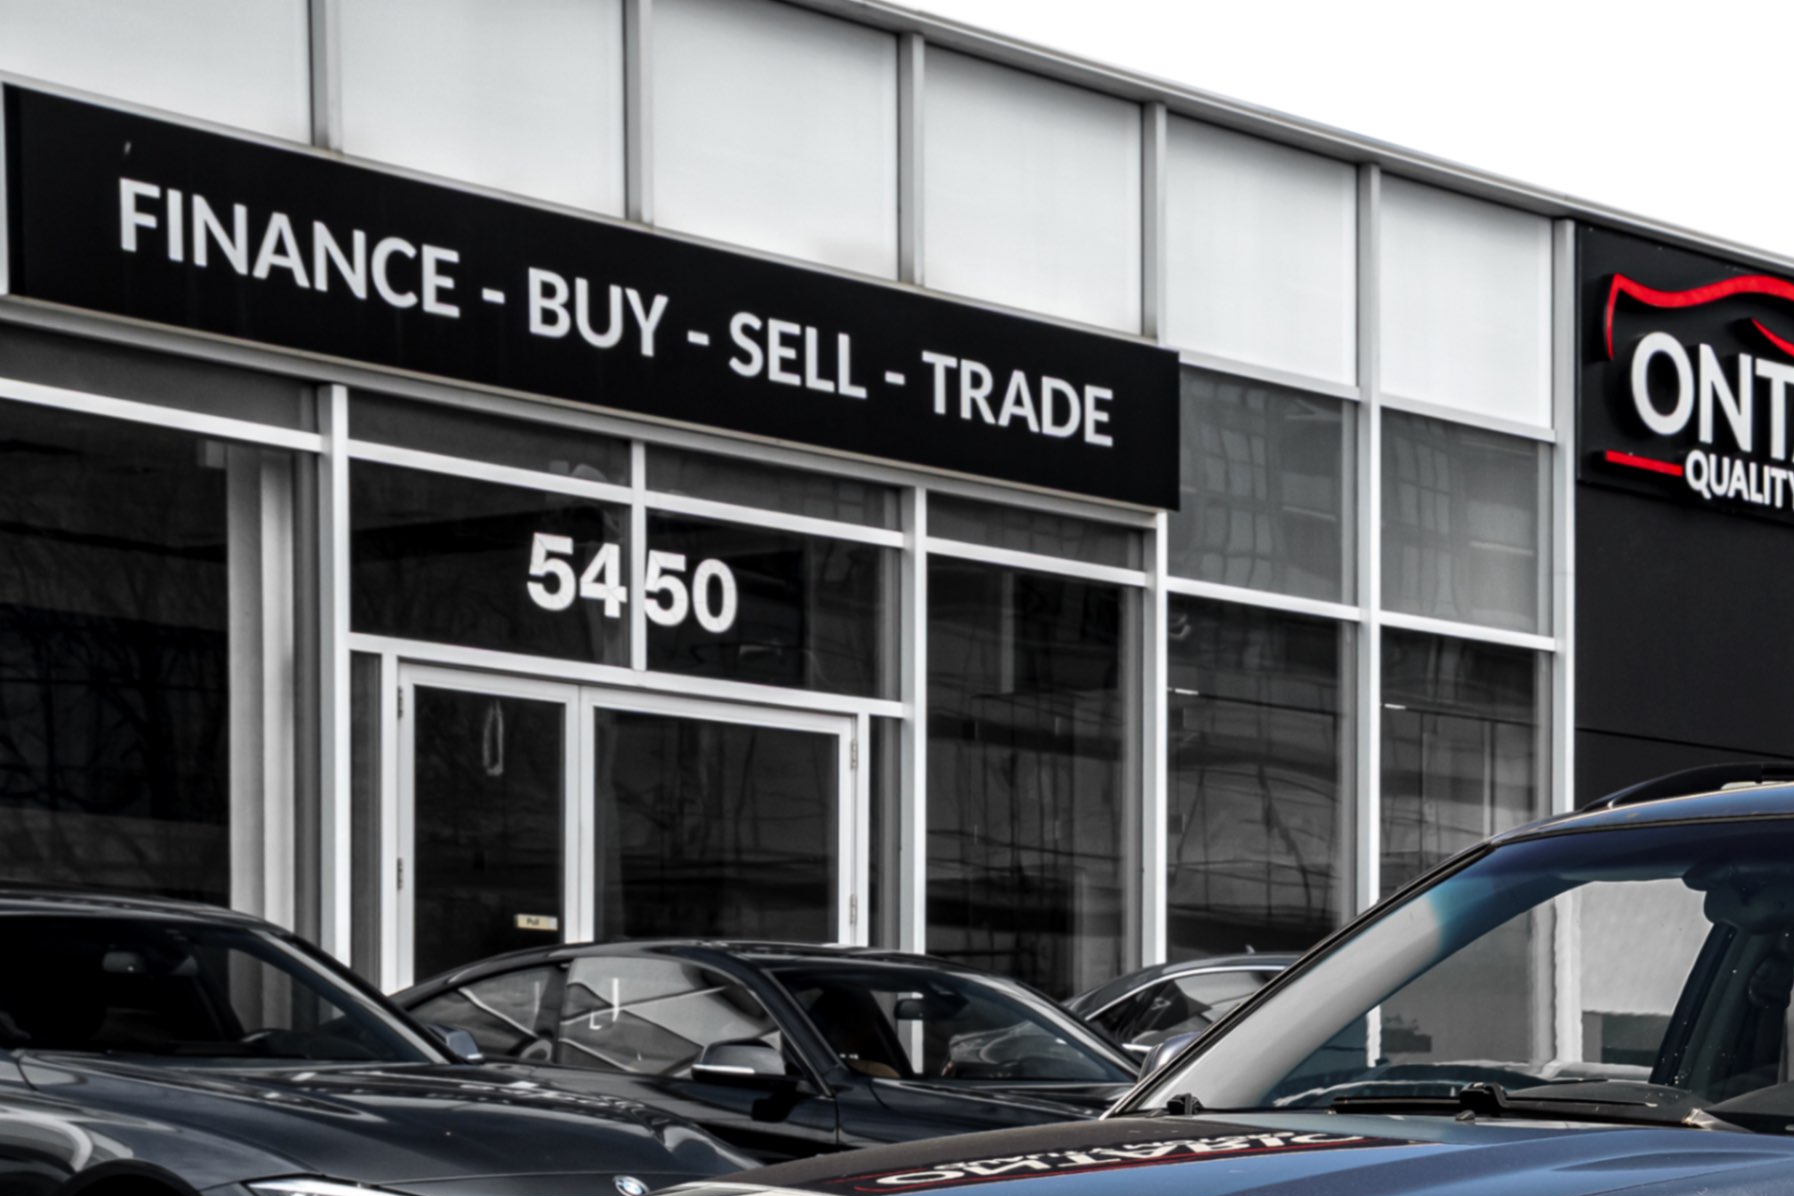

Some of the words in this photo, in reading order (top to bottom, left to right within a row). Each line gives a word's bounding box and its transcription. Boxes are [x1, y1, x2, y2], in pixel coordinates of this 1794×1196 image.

[118, 176, 461, 319] FINANCE
[482, 287, 505, 304] -
[528, 267, 669, 357] BUY
[687, 330, 710, 346] -
[729, 311, 867, 399] SELL
[884, 371, 906, 386] -
[921, 350, 1113, 447] TRADE
[526, 531, 738, 634] 5450
